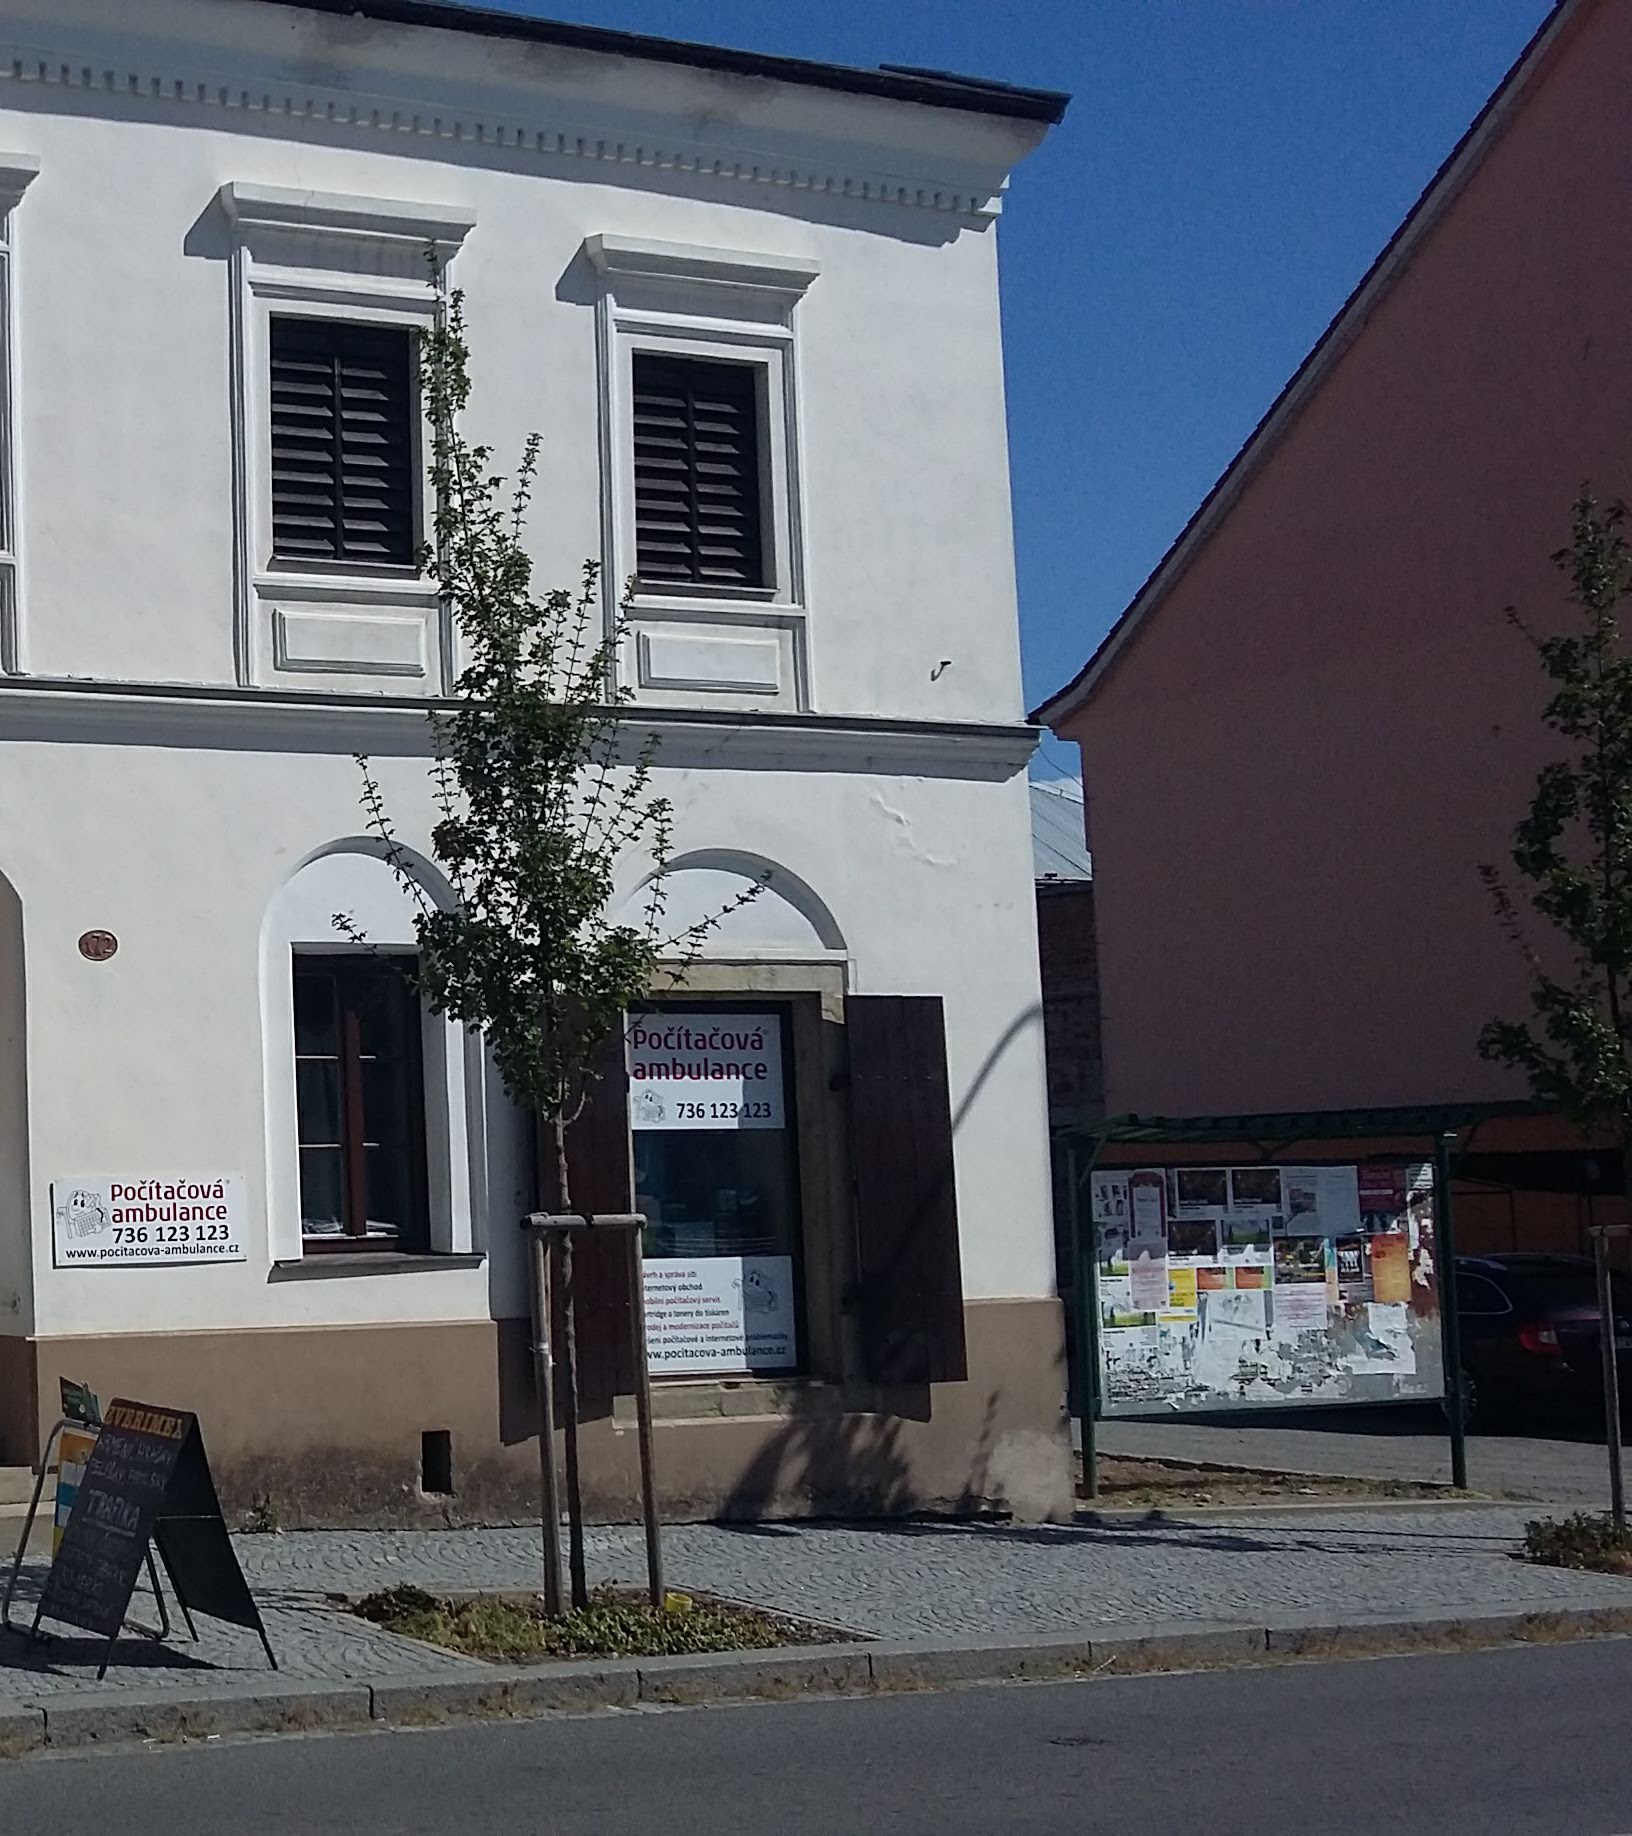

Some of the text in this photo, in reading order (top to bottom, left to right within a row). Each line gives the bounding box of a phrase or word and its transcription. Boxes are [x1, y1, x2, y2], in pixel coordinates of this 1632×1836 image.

[633, 1026, 764, 1050] Počítačová
[633, 1057, 768, 1081] ambulance
[676, 1102, 772, 1119] 736 123 123
[111, 1178, 224, 1201] Počítačová
[111, 1202, 227, 1224] ambulance
[112, 1224, 230, 1244] 736 123 123
[66, 1243, 240, 1259] www.pocitacova-ambulance.cz
[678, 1282, 703, 1291] obchod
